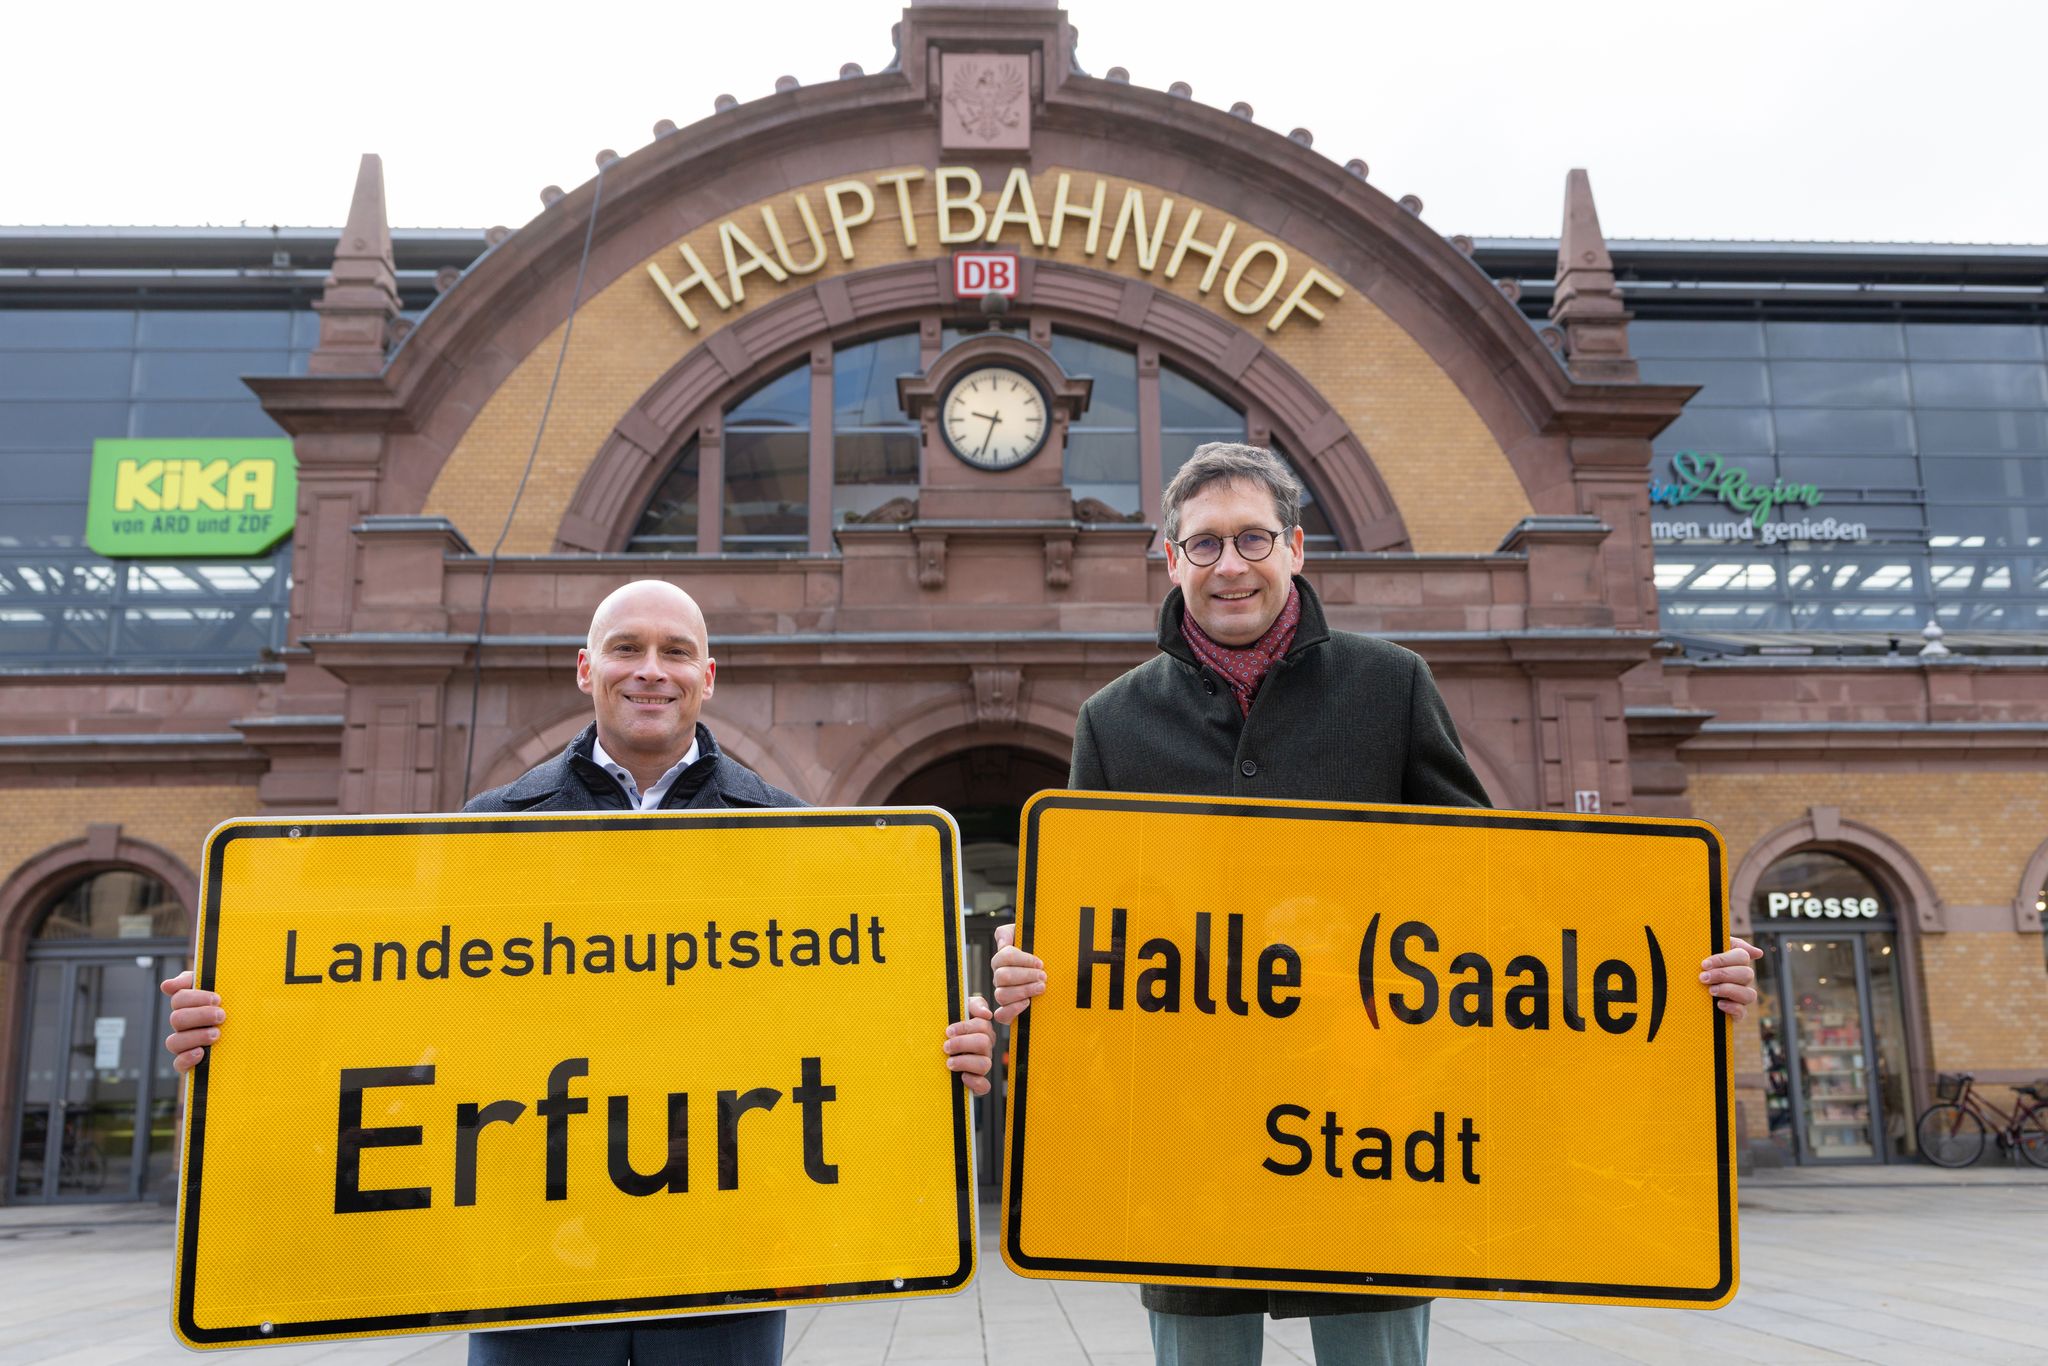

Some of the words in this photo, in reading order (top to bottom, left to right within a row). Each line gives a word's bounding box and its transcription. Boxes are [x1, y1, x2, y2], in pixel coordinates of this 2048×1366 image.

[647, 167, 1345, 330] HAUPTBAHNHOF
[963, 260, 1009, 289] DB
[112, 519, 144, 534] von
[152, 515, 190, 533] ARD
[196, 515, 230, 533] und
[237, 514, 272, 533] ZDF
[1651, 521, 1700, 539] men
[1708, 517, 1753, 539] und
[1761, 517, 1867, 544] genießen
[1717, 467, 1824, 528] Region
[1768, 892, 1879, 918] Presse
[285, 914, 887, 986] Landeshauptstadt
[1076, 907, 1302, 1019] Halle
[1358, 912, 1668, 1043] (Saale)
[334, 1056, 839, 1215] Erfurt
[1262, 1104, 1481, 1185] Stadt
